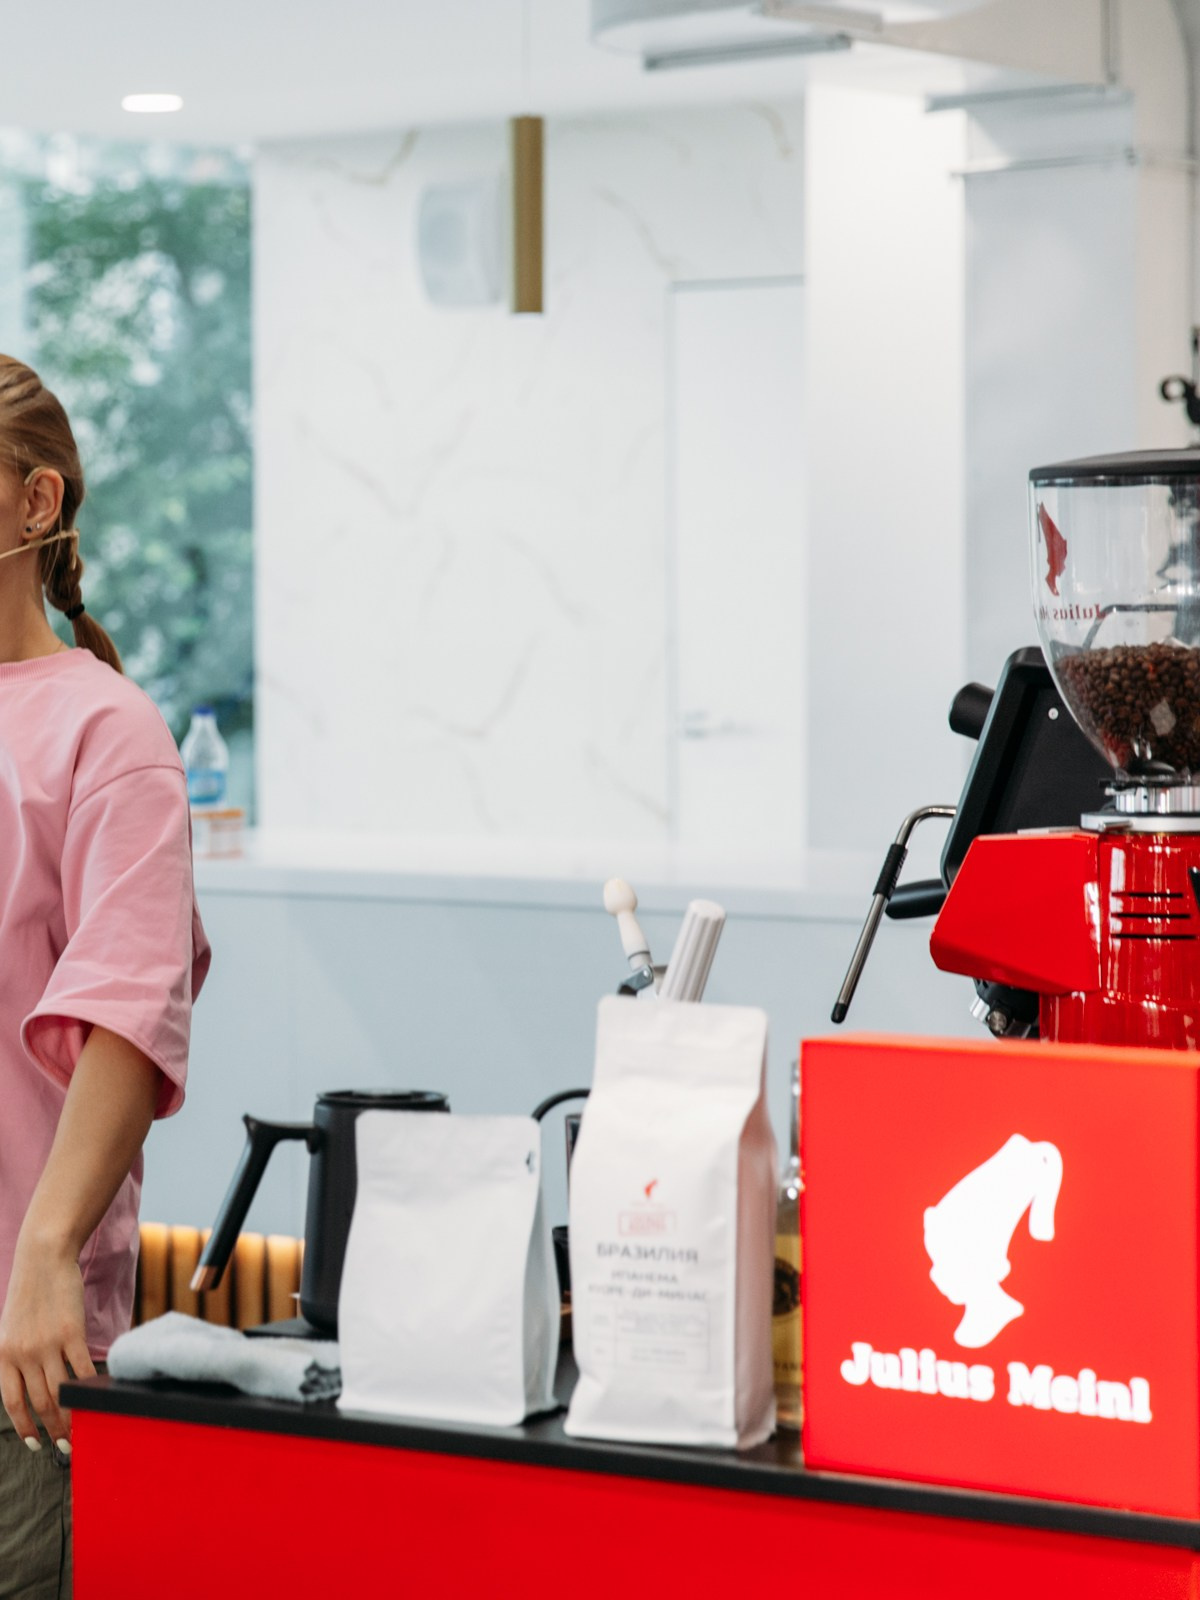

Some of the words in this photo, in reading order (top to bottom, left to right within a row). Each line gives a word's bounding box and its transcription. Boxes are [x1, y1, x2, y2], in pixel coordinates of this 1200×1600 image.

[597, 1243, 698, 1263] БРАЗИЛИЯ
[611, 1270, 678, 1284] ИПАНЕМА
[840, 1341, 995, 1402] Julius
[1007, 1361, 1152, 1424] Meinl
